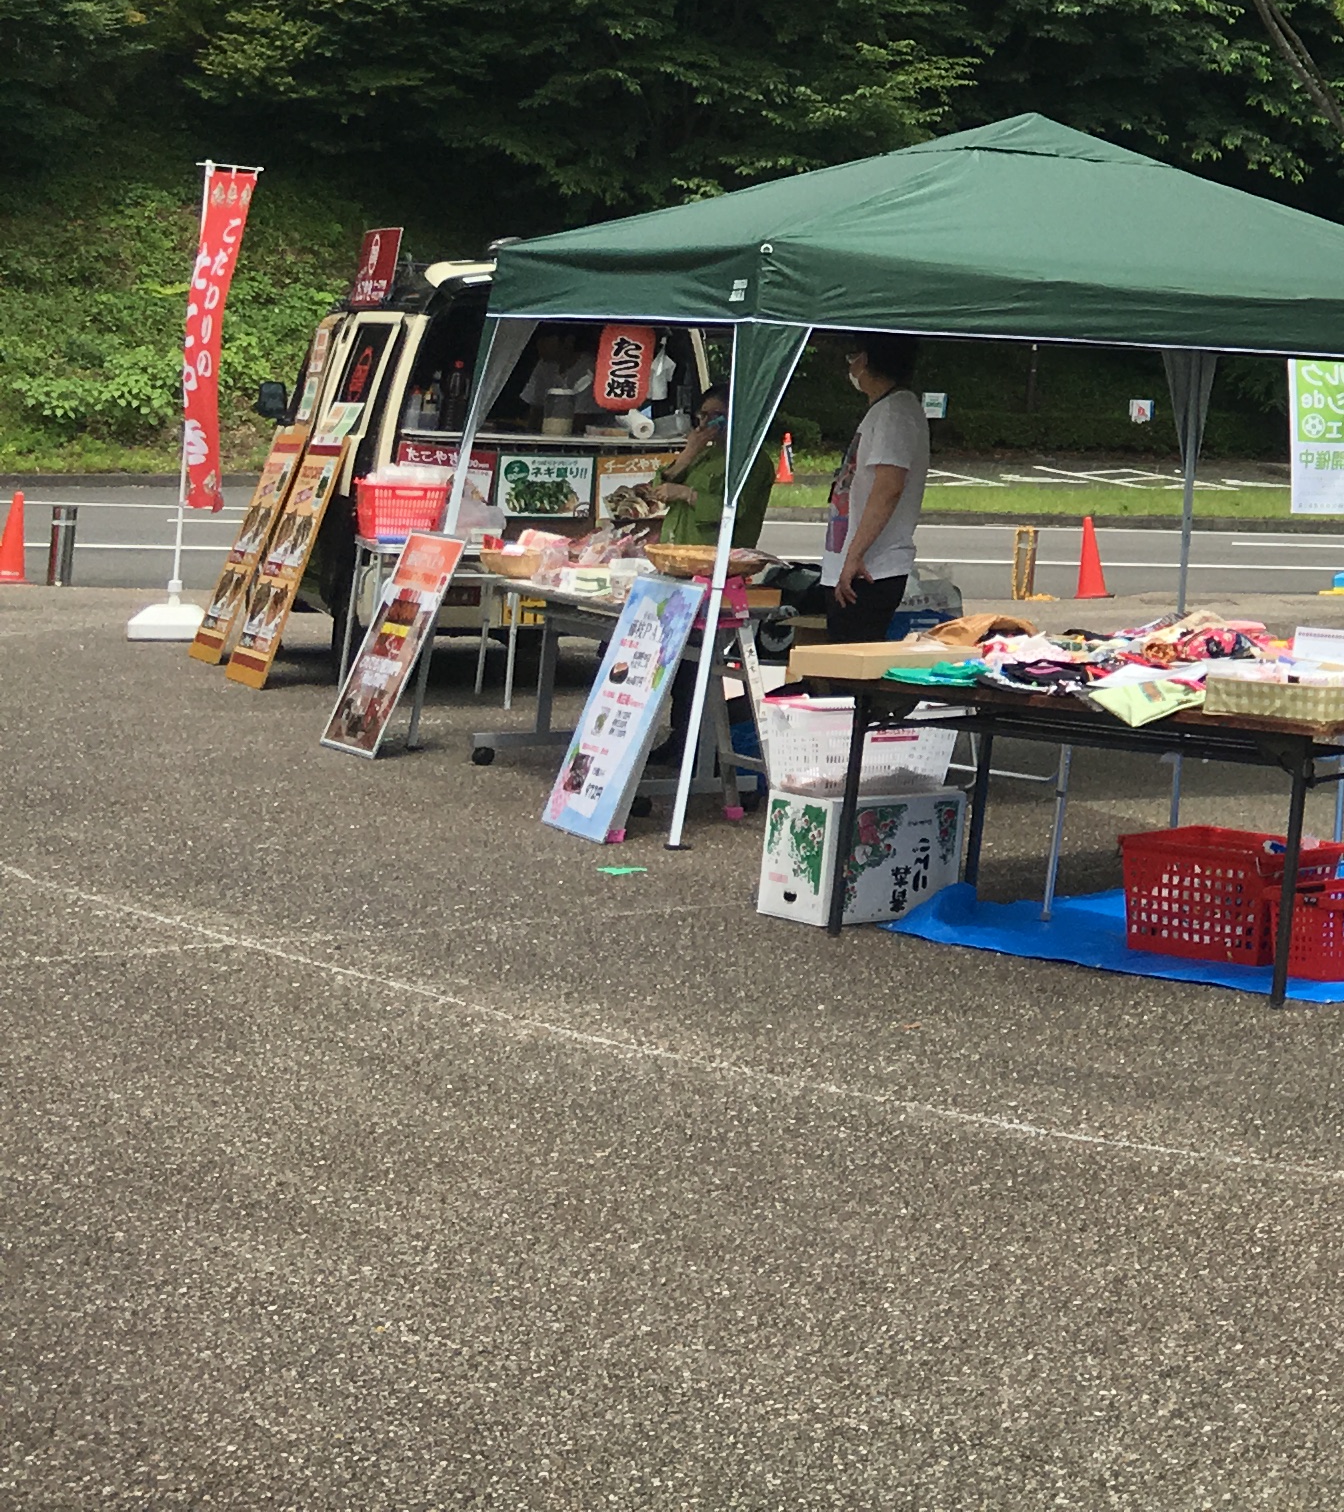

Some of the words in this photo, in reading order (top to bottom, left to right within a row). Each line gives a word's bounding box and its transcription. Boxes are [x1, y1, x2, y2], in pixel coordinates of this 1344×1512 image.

[197, 217, 241, 377] こだわりの
[605, 336, 643, 399] たこ焼
[890, 865, 912, 913] 青森
[912, 838, 931, 892] りんご
